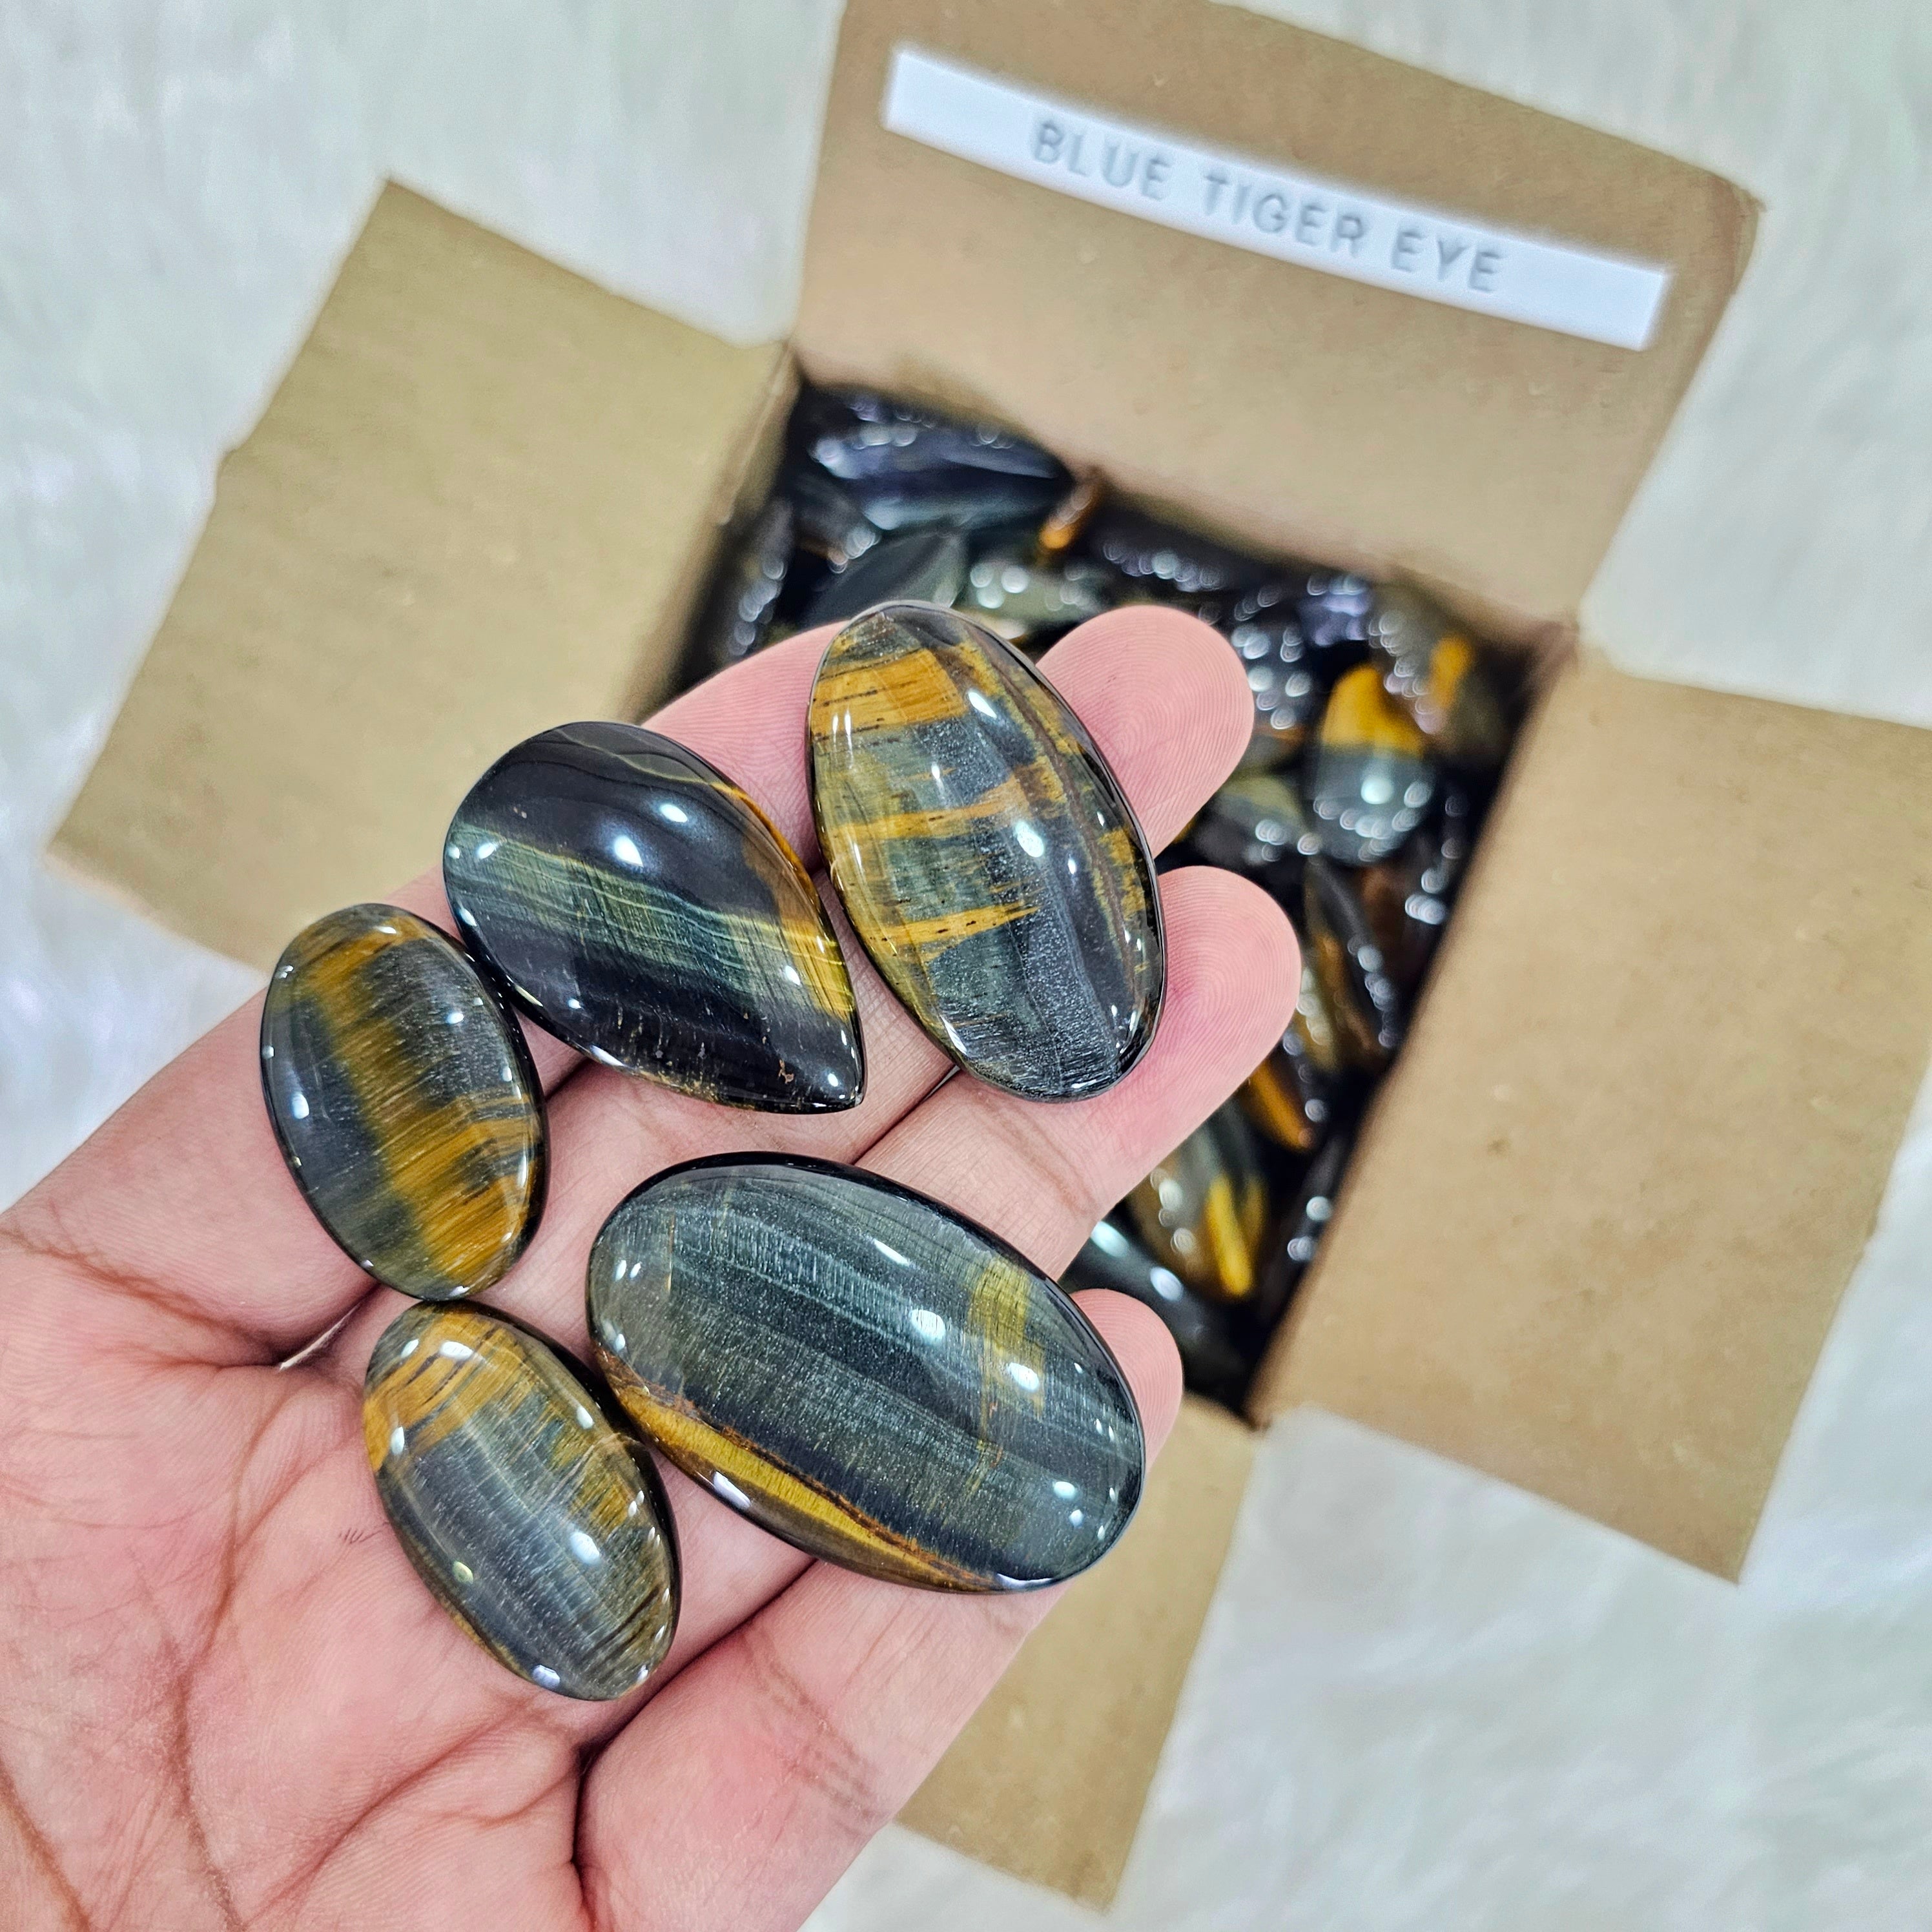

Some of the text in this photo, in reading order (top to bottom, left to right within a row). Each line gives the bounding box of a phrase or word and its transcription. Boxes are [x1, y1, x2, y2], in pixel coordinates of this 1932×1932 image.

[1031, 118, 1503, 294] BLUE TIGER EYE
